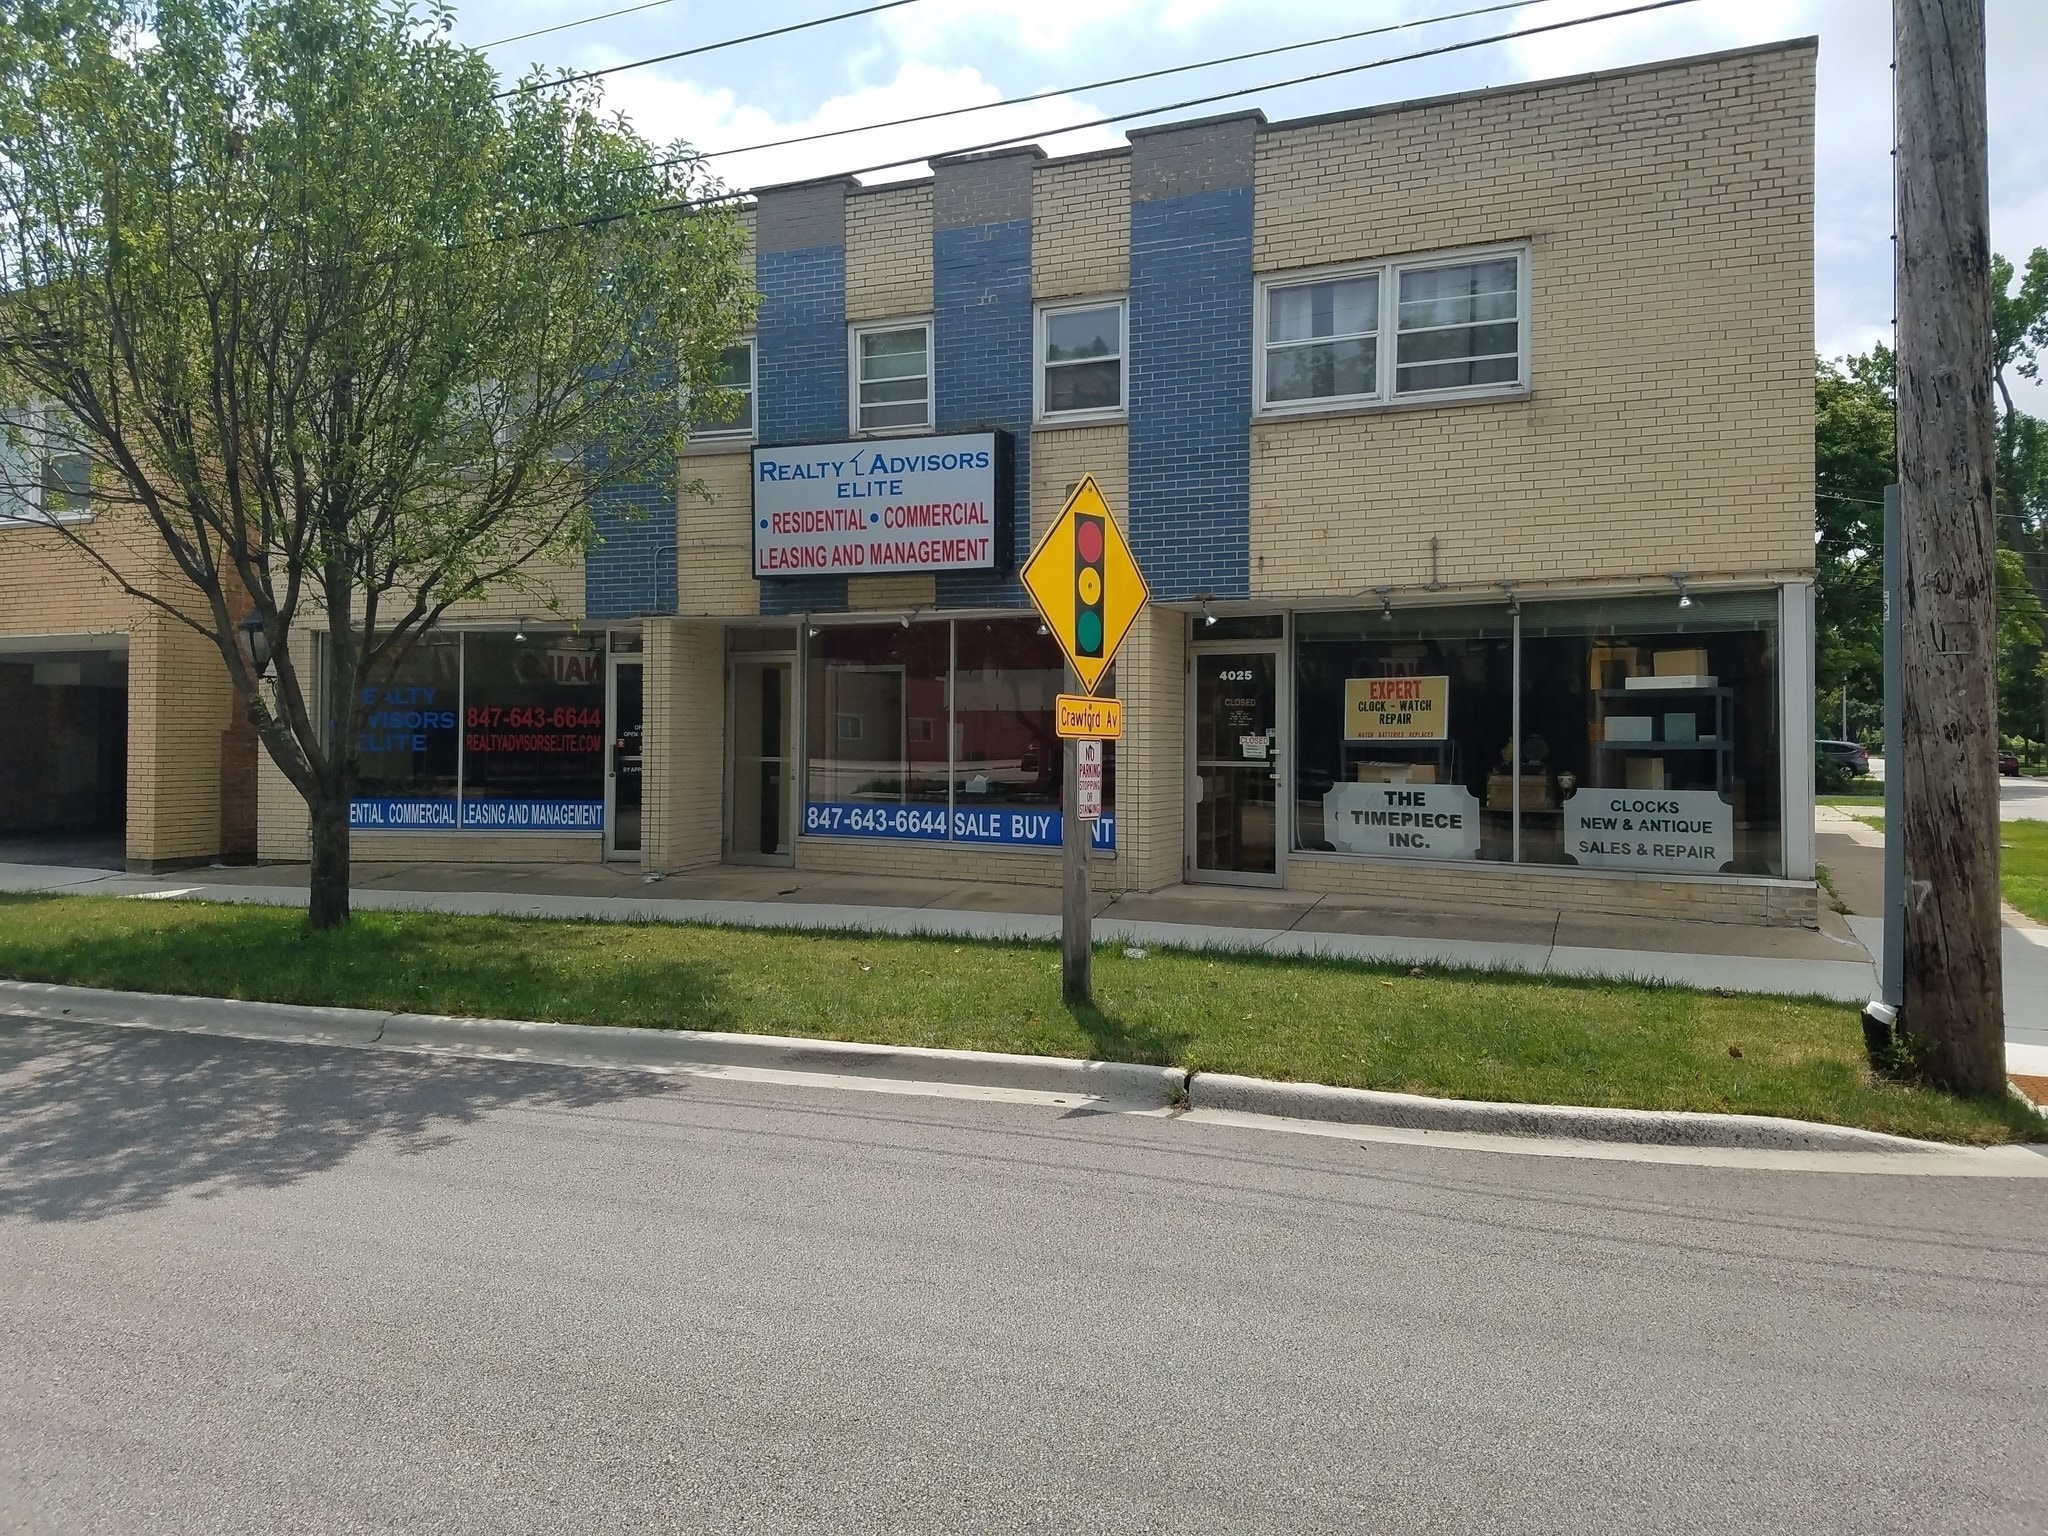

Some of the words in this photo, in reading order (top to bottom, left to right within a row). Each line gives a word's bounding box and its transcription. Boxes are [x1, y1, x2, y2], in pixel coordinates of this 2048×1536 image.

[759, 461, 845, 482] REALTY
[868, 451, 990, 475] ADVISORS
[837, 479, 903, 499] ELITE
[772, 508, 868, 534] RESIDENTIAL
[884, 502, 989, 529] COMMERCIAL
[760, 545, 827, 570] LEASING
[831, 543, 864, 567] AND
[870, 538, 989, 565] MANAGEMENT
[1219, 670, 1252, 681] 4025
[1370, 680, 1421, 699] EXPERT
[1224, 698, 1256, 706] CLOSED
[1358, 701, 1386, 712] CLOCK
[1399, 700, 1432, 711] WATCH
[467, 707, 601, 728] 847-643-6644
[1061, 706, 1100, 728] Crawford
[1107, 710, 1117, 728] Av
[1379, 713, 1412, 725] REPAIR
[467, 734, 602, 752] REALTYADVISORSELITE.COM
[1240, 737, 1269, 745] CLOSED
[1085, 746, 1095, 762] NO
[1079, 763, 1100, 778] PARKING
[1079, 781, 1100, 791] STOPPING
[1087, 792, 1093, 802] OR
[1384, 791, 1426, 806] THE
[350, 803, 384, 824] ENTIAL
[389, 803, 455, 824] COMMERCIAL
[463, 804, 506, 825] LEASING
[507, 804, 529, 824] AND
[531, 804, 603, 825] MANAGEMENT
[1079, 804, 1100, 815] STANDING
[1610, 800, 1679, 814] CLOCKS
[807, 806, 947, 834] 847-643-6644
[954, 811, 1001, 837] SALE
[1011, 814, 1051, 840] BUY
[1350, 810, 1462, 829] TIMEPIECE
[1580, 816, 1618, 830] NEW
[1622, 818, 1633, 831] &
[1638, 819, 1713, 834] ANTIQUE
[1388, 832, 1430, 848] INC.
[1579, 840, 1631, 855] SALES
[1636, 843, 1648, 856] &
[1653, 844, 1716, 859] REPAIR
